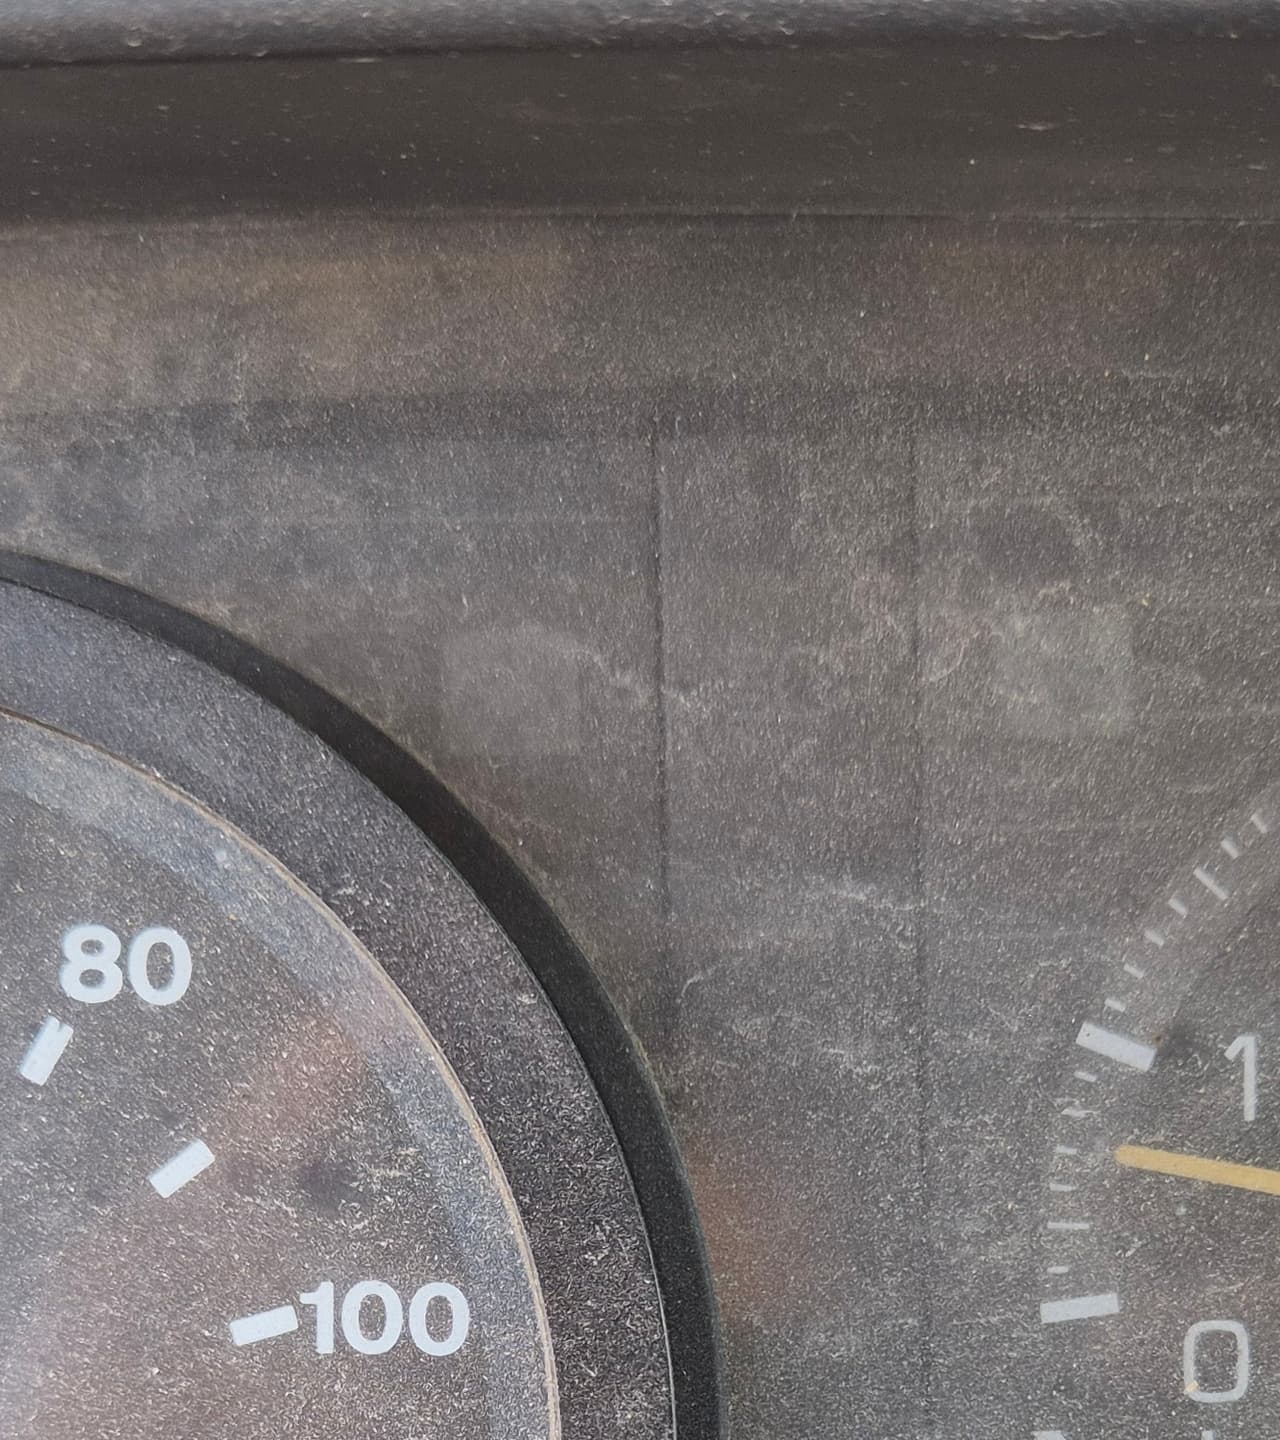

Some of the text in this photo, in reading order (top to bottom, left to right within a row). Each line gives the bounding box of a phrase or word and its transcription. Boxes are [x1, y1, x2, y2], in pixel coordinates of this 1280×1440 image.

[59, 924, 192, 1005] 80
[1224, 1034, 1257, 1122] 1
[300, 1281, 470, 1356] 100
[1183, 1320, 1252, 1402] 0
